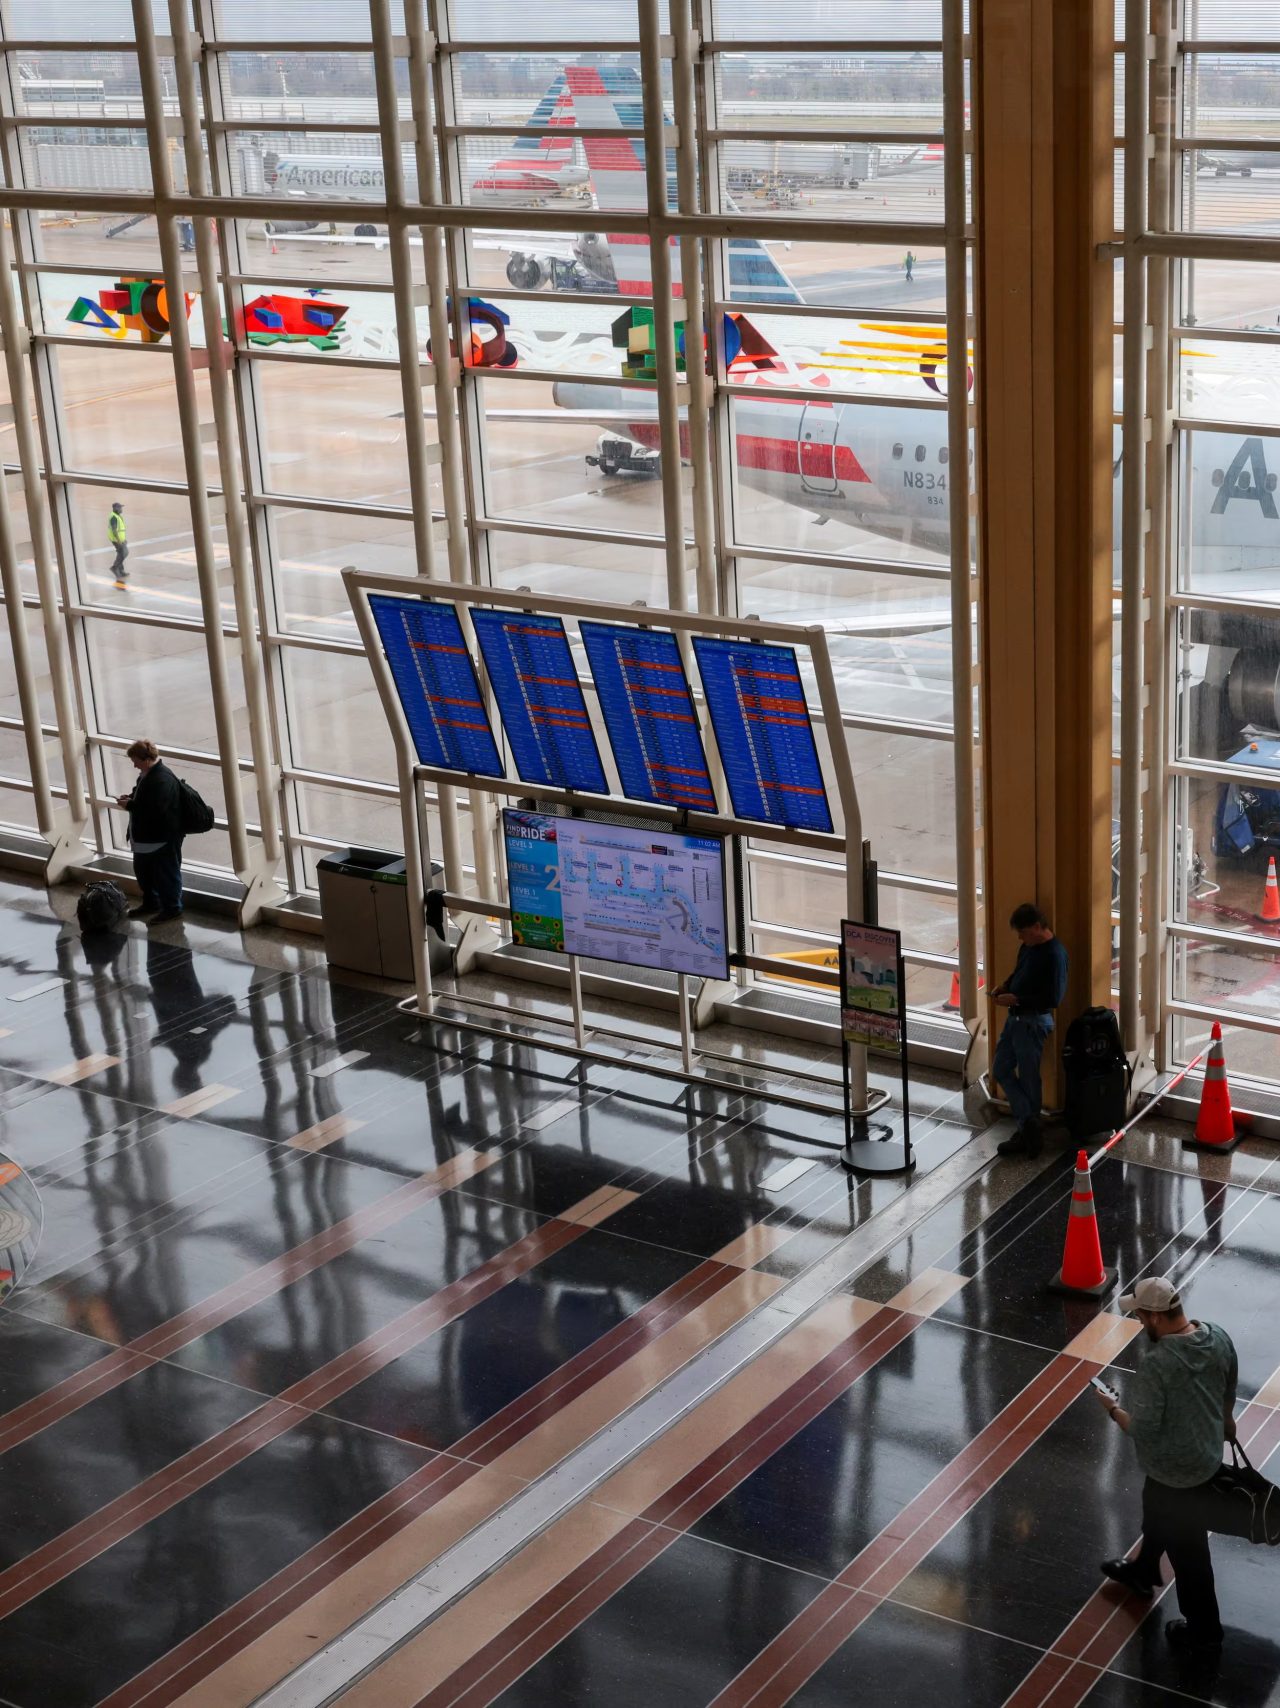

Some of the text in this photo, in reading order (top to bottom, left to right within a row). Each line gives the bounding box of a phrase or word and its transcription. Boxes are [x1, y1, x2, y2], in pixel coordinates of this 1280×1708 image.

[286, 164, 383, 187] American
[520, 826, 546, 840] RIDE
[509, 839, 527, 848] LEVEL
[511, 862, 529, 871] LEVEL
[544, 864, 561, 893] 2
[512, 886, 531, 896] LEVEL
